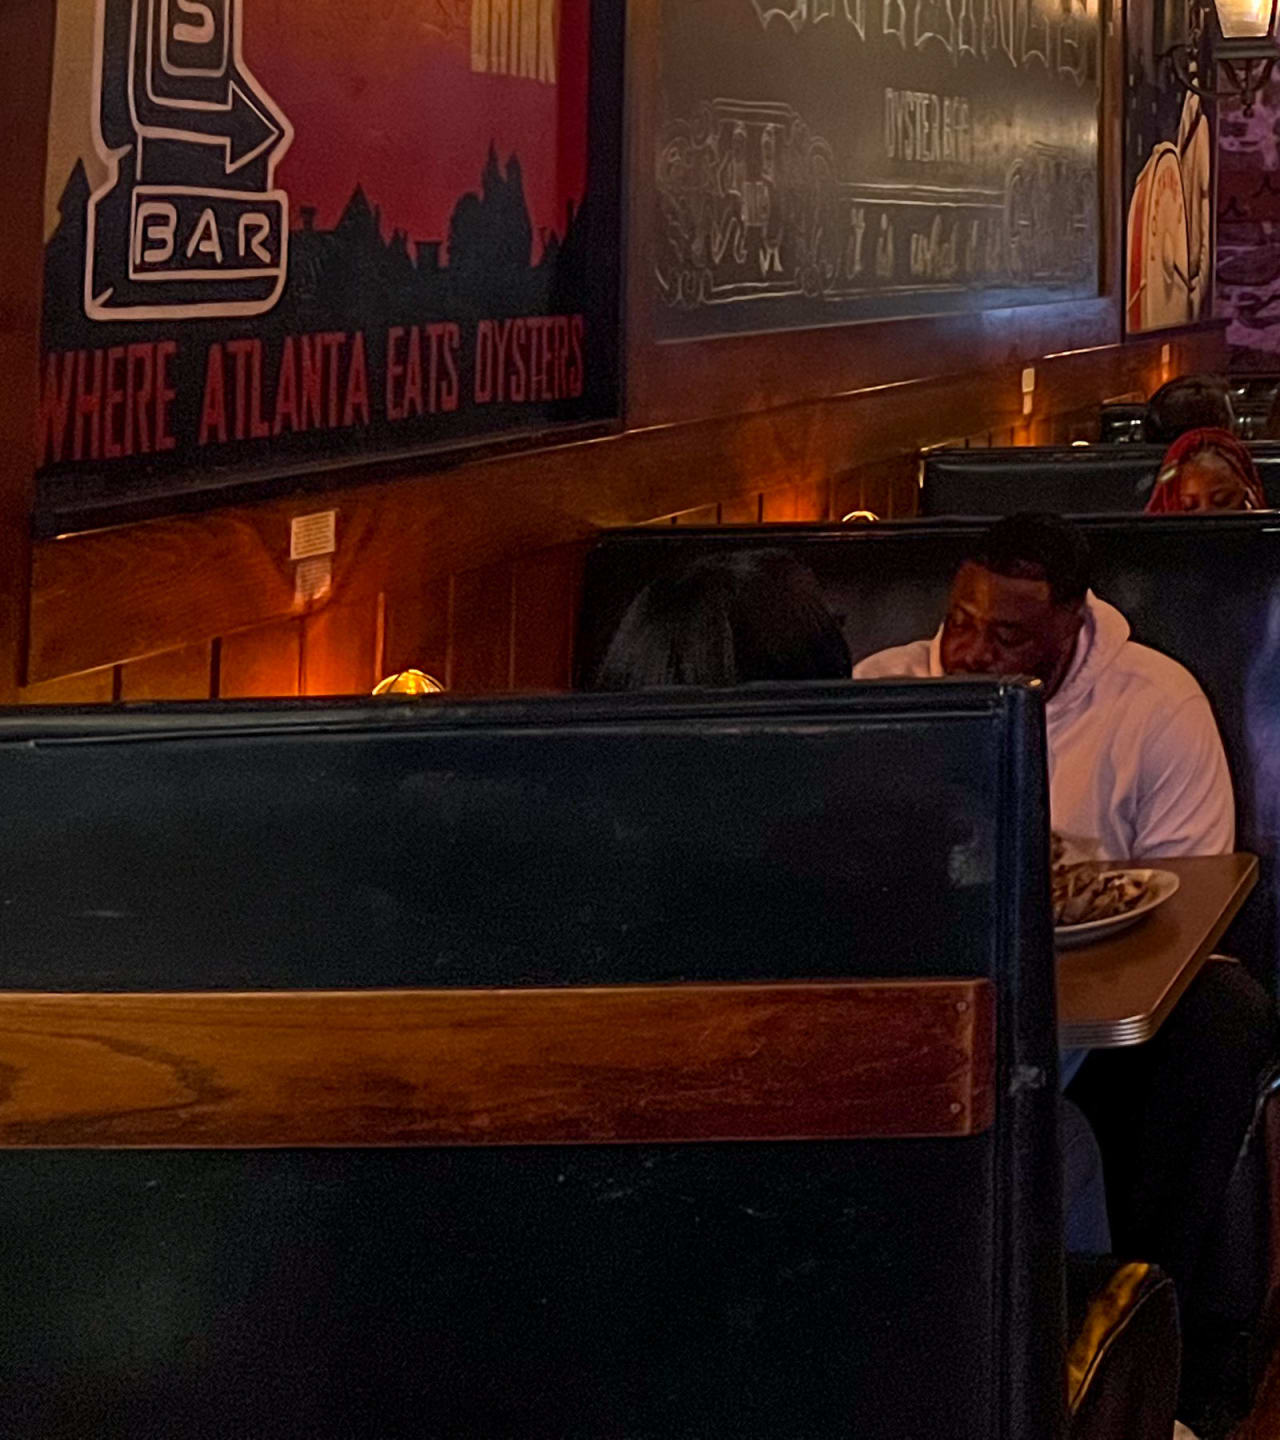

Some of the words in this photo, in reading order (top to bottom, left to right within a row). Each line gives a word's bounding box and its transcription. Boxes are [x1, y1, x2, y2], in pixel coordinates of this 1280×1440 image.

[134, 202, 271, 264] BAR
[40, 340, 176, 461] WHERE
[199, 329, 369, 445] ATLANTA
[386, 320, 460, 420] EATS
[474, 314, 584, 404] OYSTERS
